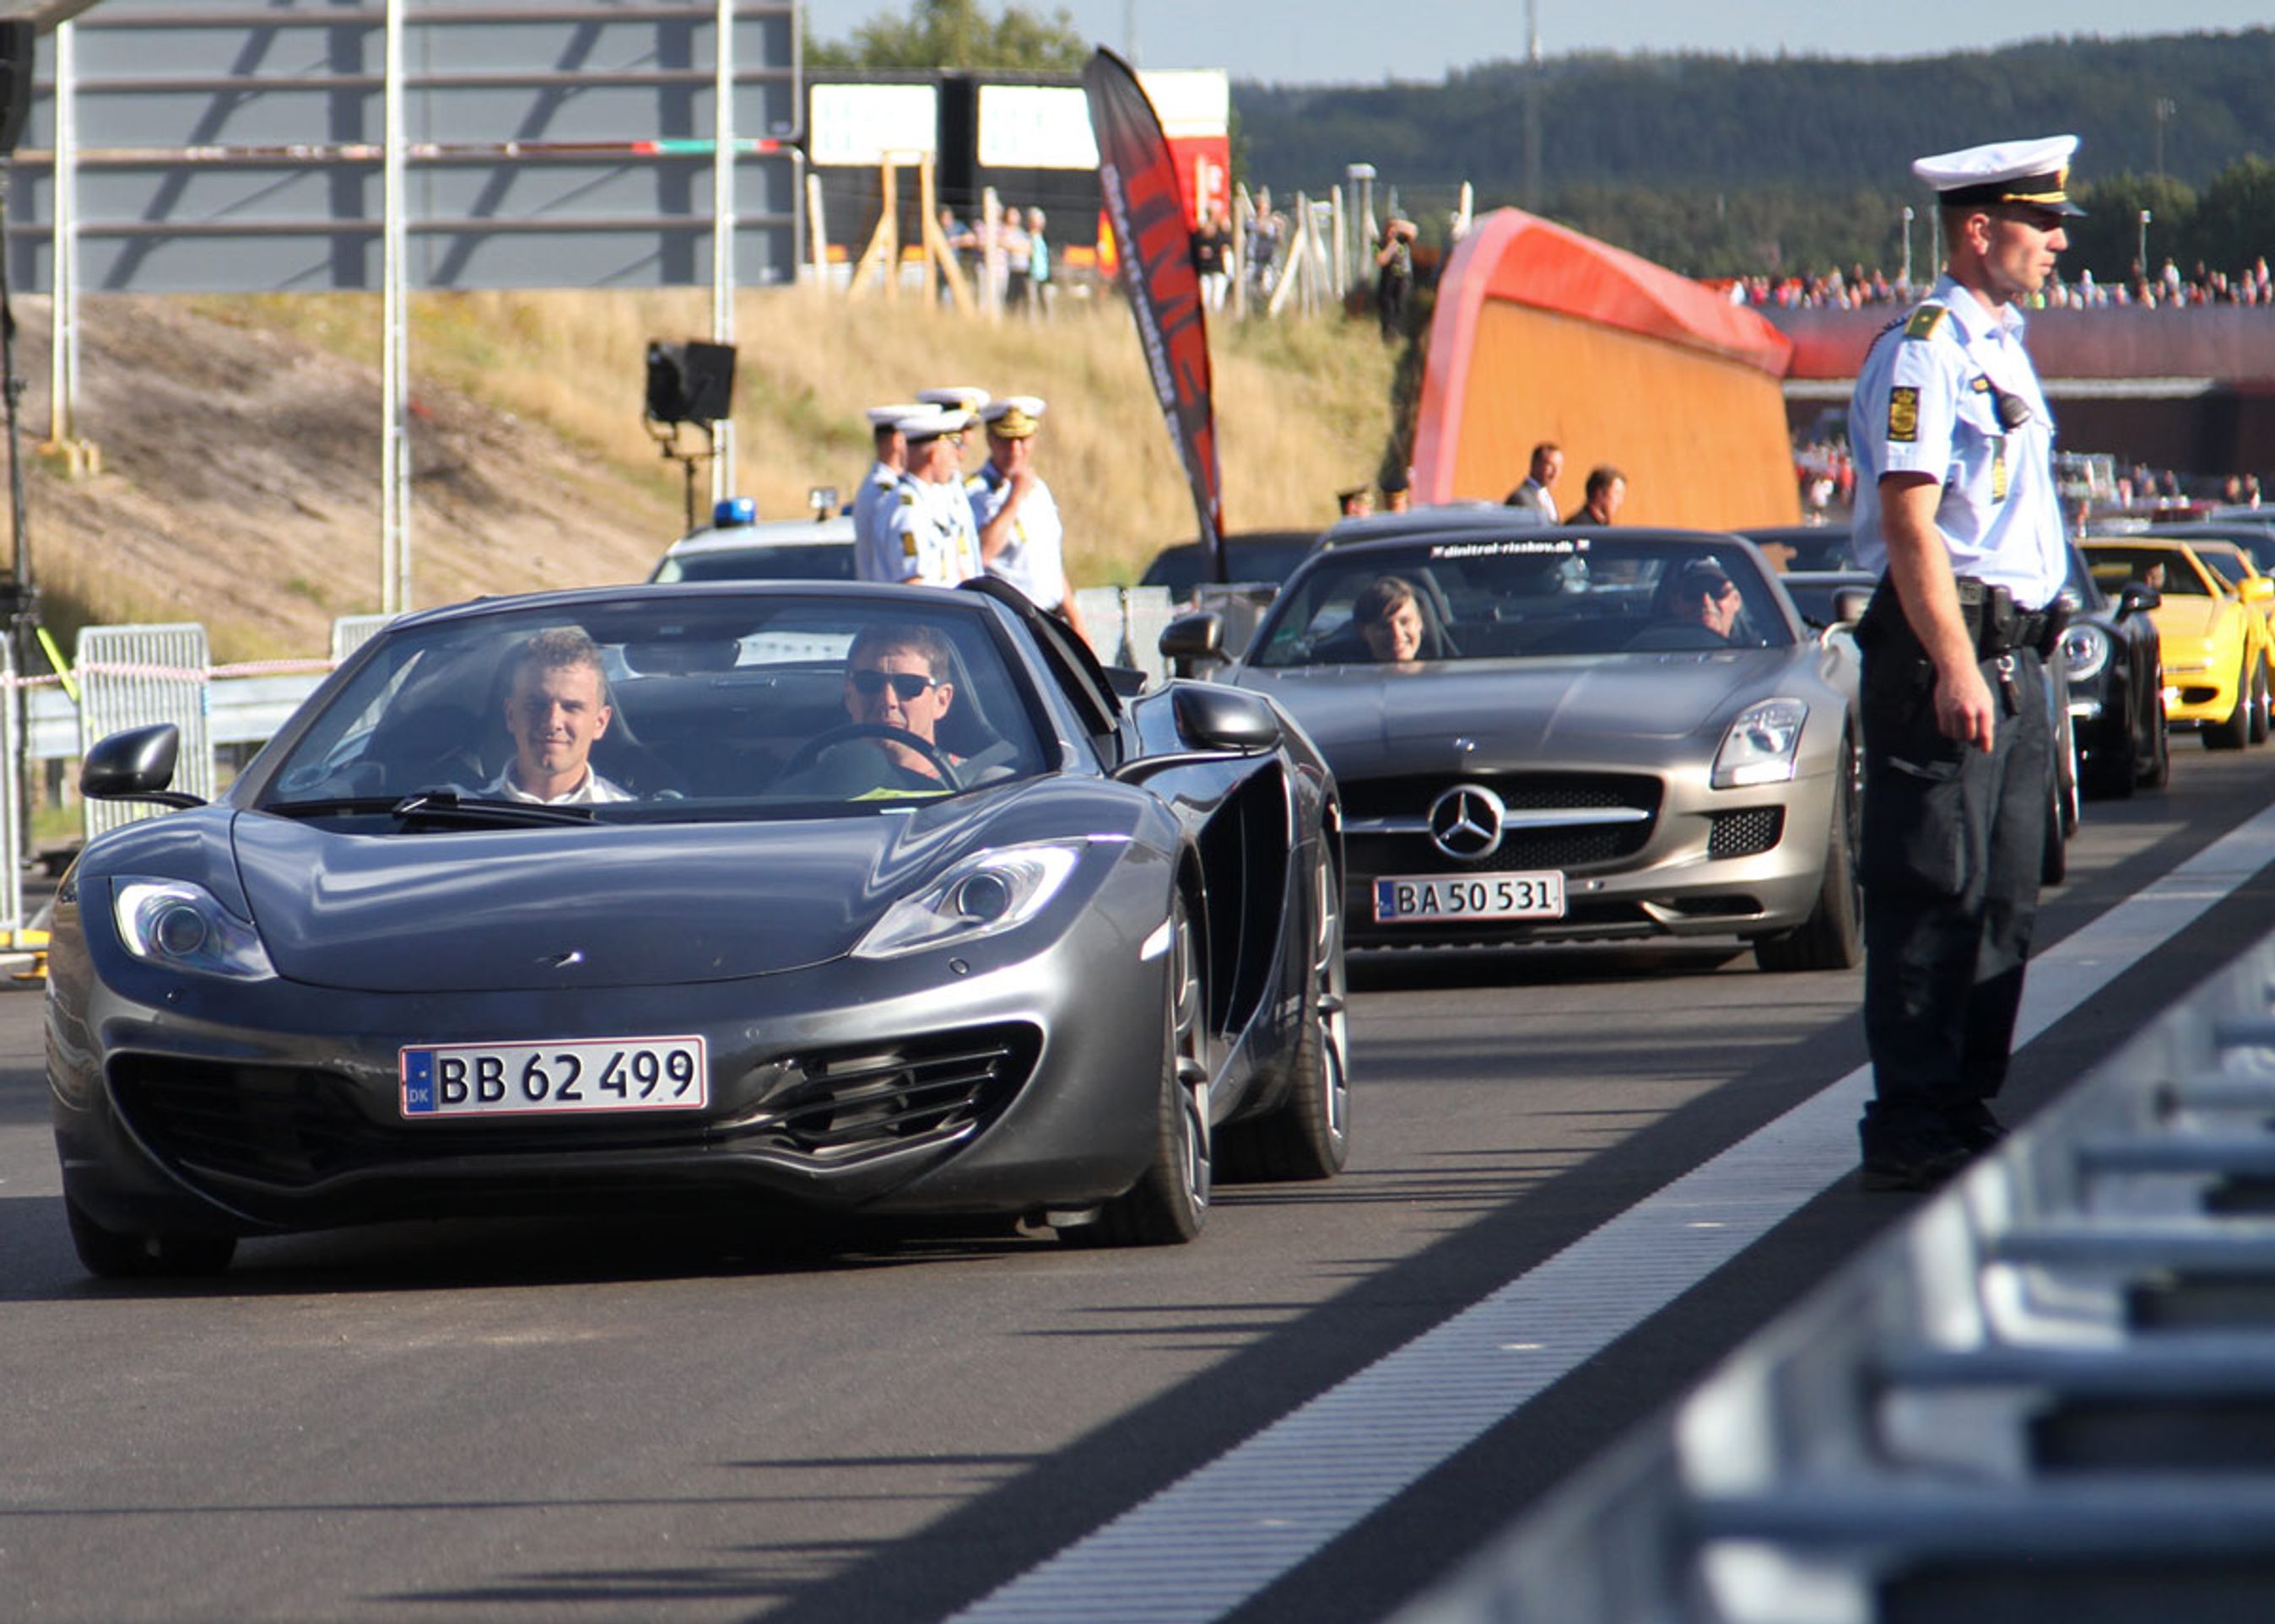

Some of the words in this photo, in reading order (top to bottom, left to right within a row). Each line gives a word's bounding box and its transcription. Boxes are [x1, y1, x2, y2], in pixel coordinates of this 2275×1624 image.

[1397, 885, 1440, 914] BA
[1448, 882, 1488, 912] 50
[1496, 881, 1552, 910] 531
[439, 1056, 506, 1104] BB
[521, 1052, 583, 1102] 62
[599, 1049, 694, 1098] 499
[409, 1088, 429, 1103] DK
